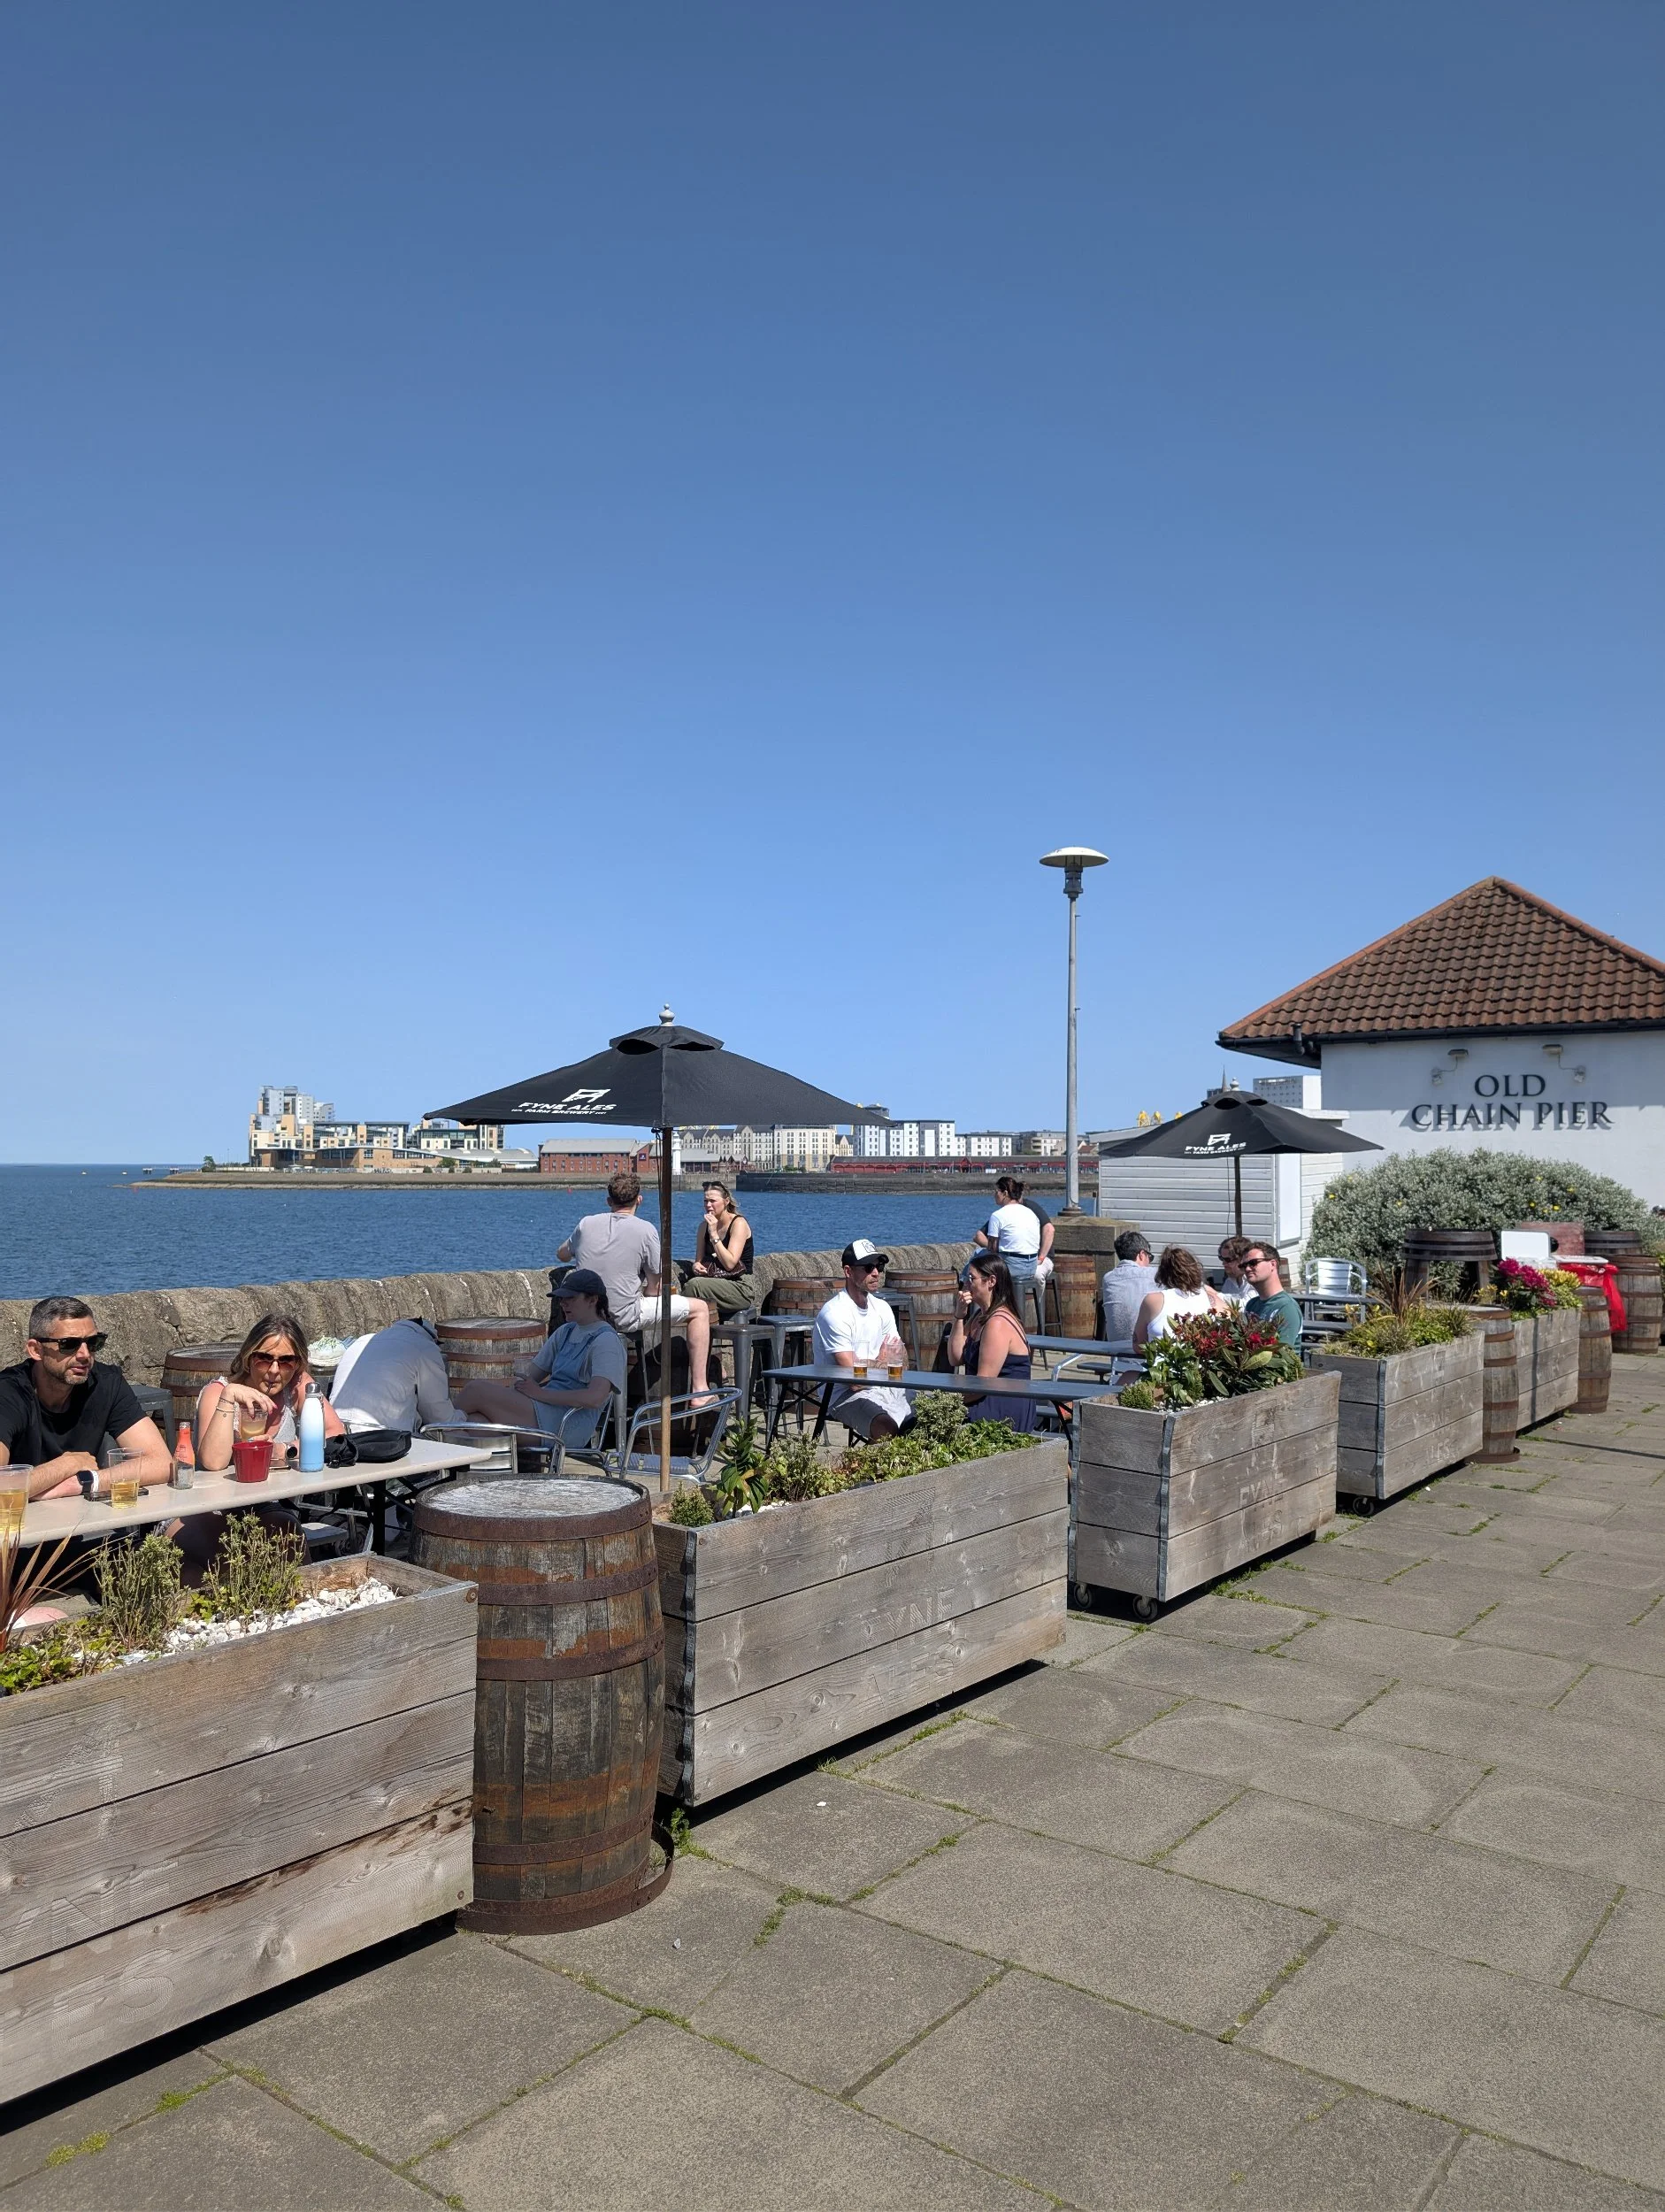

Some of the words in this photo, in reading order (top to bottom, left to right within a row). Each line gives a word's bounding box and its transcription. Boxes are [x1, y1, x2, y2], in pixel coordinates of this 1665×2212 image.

[1474, 1074, 1546, 1097] OLD
[518, 1102, 567, 1110] FYNE
[1411, 1102, 1523, 1126] CHAIN
[1537, 1101, 1615, 1125] PIER
[1217, 1141, 1247, 1151] ALES
